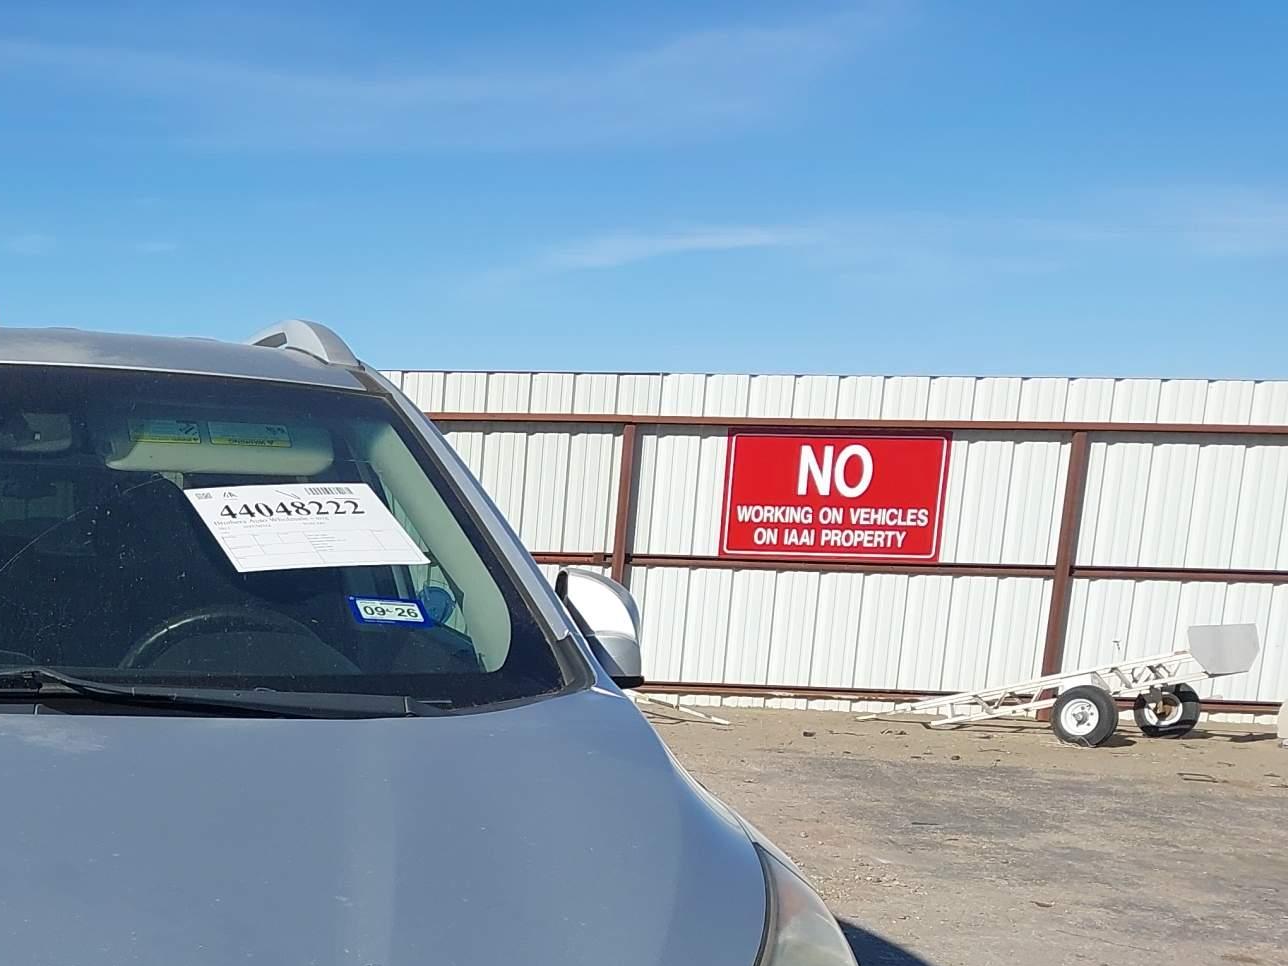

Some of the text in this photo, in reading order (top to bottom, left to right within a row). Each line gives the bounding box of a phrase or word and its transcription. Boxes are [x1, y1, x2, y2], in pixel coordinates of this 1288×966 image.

[797, 444, 873, 498] NO
[220, 500, 365, 519] 44048222
[737, 505, 929, 527] WORKING ON VEHICLES
[754, 528, 906, 548] ON IAAI PROPERTY
